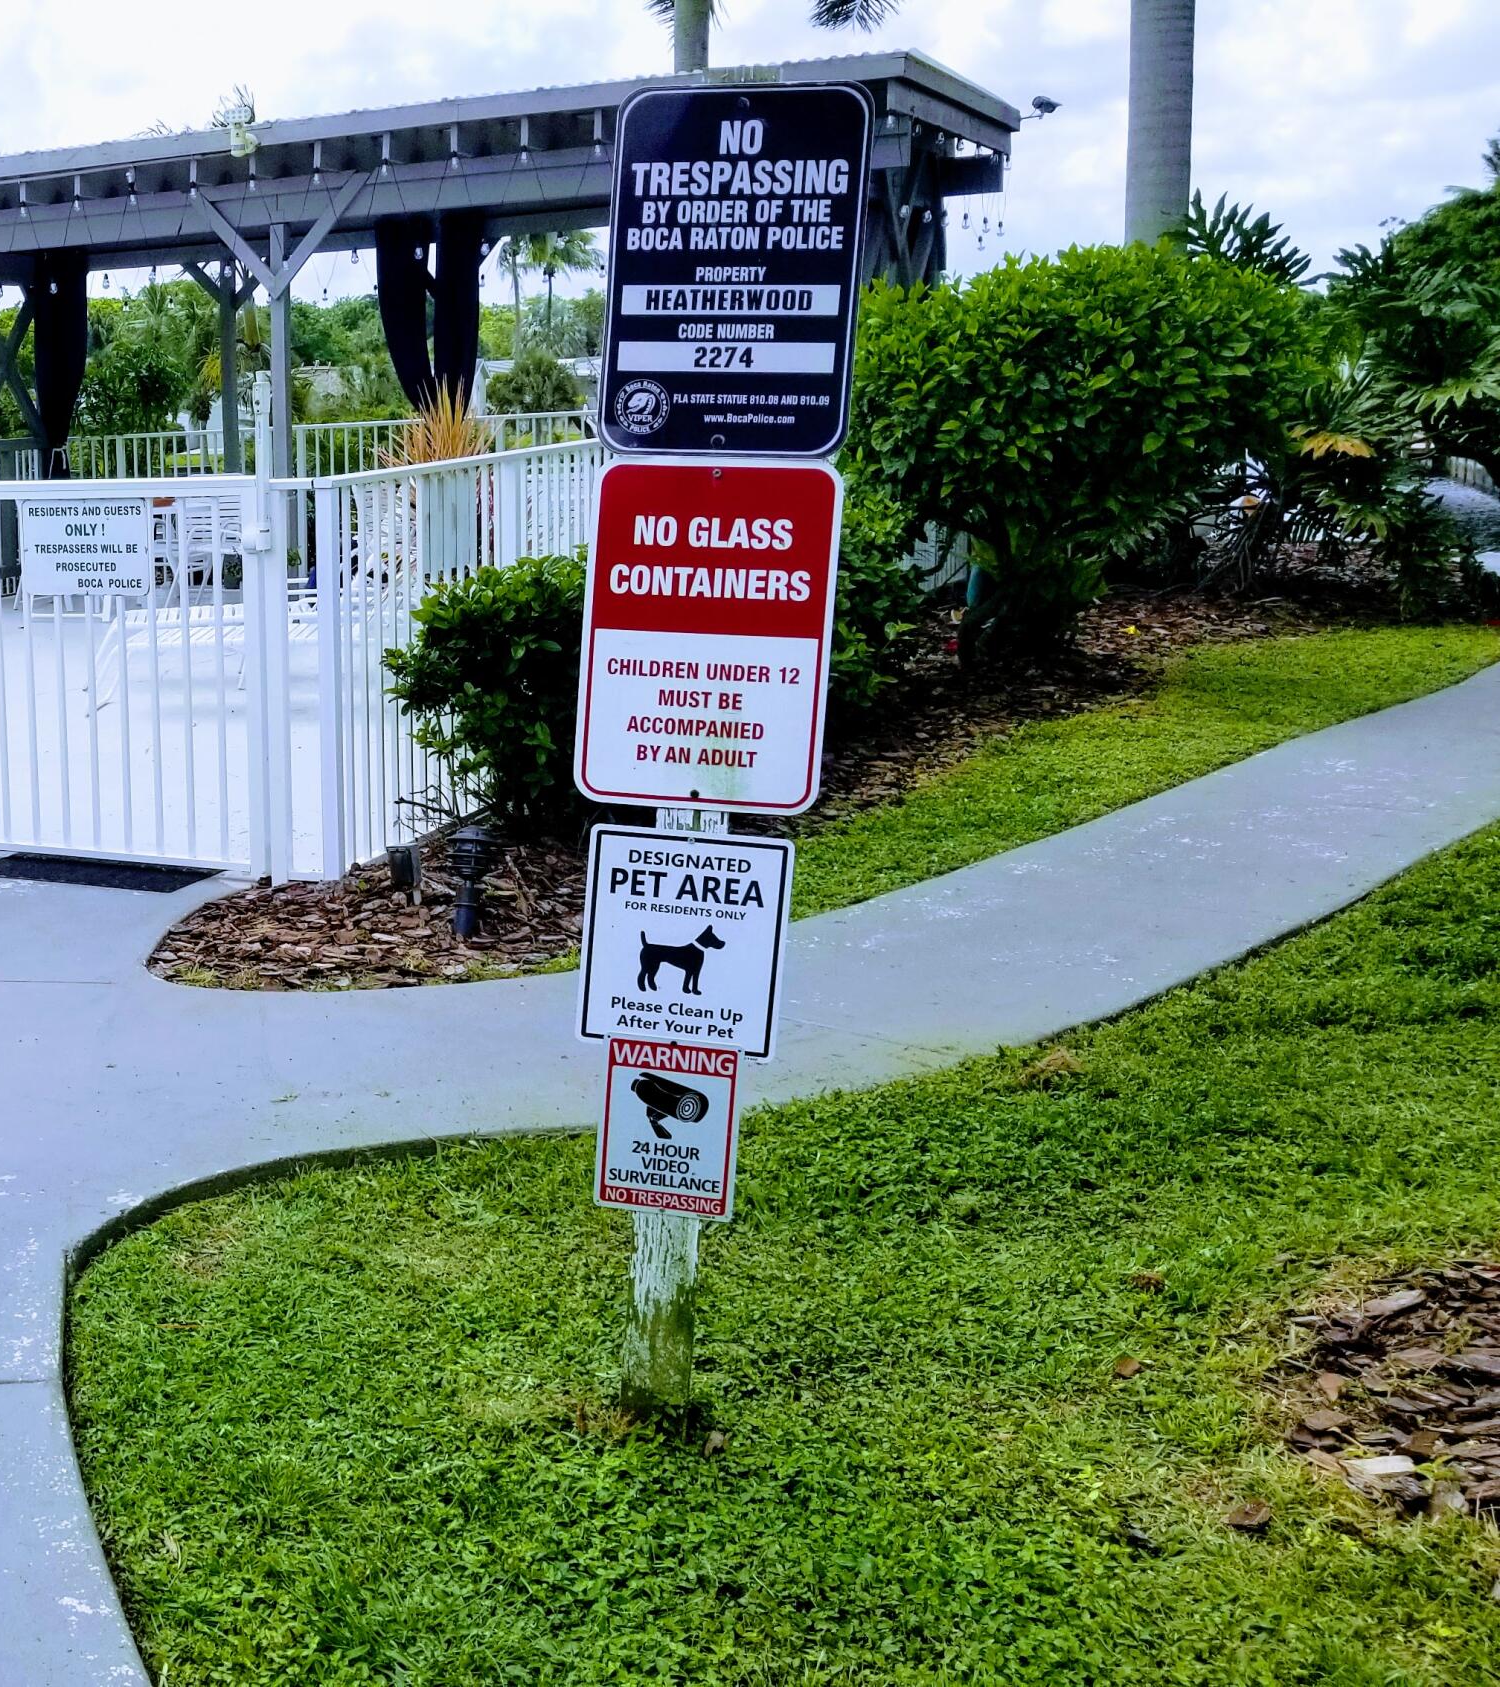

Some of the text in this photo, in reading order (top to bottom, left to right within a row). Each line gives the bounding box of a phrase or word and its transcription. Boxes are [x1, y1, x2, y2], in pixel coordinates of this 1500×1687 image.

[719, 120, 763, 155] NO
[631, 159, 849, 197] TRESPASSING
[642, 199, 831, 224] BY ORDER OF THE
[627, 226, 843, 251] BOCA RATON POLICE
[695, 266, 767, 282] PROPERTY
[645, 289, 813, 311] HEATHERWOOD
[678, 323, 775, 340] CODE NUMBER
[693, 346, 754, 369] 2274
[673, 393, 688, 404] FLA
[690, 393, 715, 404] STATE
[717, 394, 748, 405] STATUE
[780, 395, 798, 405] AND
[628, 414, 653, 422] VIPER
[703, 413, 795, 424] www.BocaPolice.com
[28, 505, 142, 517] RESIDENTS AND GUESTS
[65, 523, 98, 537] ONLY
[633, 515, 794, 550] NO GLASS
[34, 544, 138, 554] TRESPASSERS WILL BE
[55, 562, 117, 572] PROSECUTED
[78, 578, 142, 588] BOCA POLICE
[609, 564, 812, 602] CONTAINERS
[607, 658, 800, 685] CHILDREN UNDER 12
[658, 689, 743, 711] MUST BE
[626, 716, 764, 741] ACCOMPANIED
[636, 744, 758, 769] BY AN ADULT
[628, 849, 752, 874] DESIGNATED
[609, 867, 765, 908] PET AREA
[624, 900, 747, 921] FOR RESIDENTS ONLY
[611, 996, 744, 1026] Please Clean Up
[616, 1014, 734, 1040] After Your Pet
[612, 1042, 735, 1077] WARNING
[631, 1140, 700, 1161] 24 HOUR
[641, 1156, 690, 1175] VIDEO
[608, 1167, 721, 1194] SURVEILLANCE
[605, 1187, 722, 1214] NO TRESPASSING
